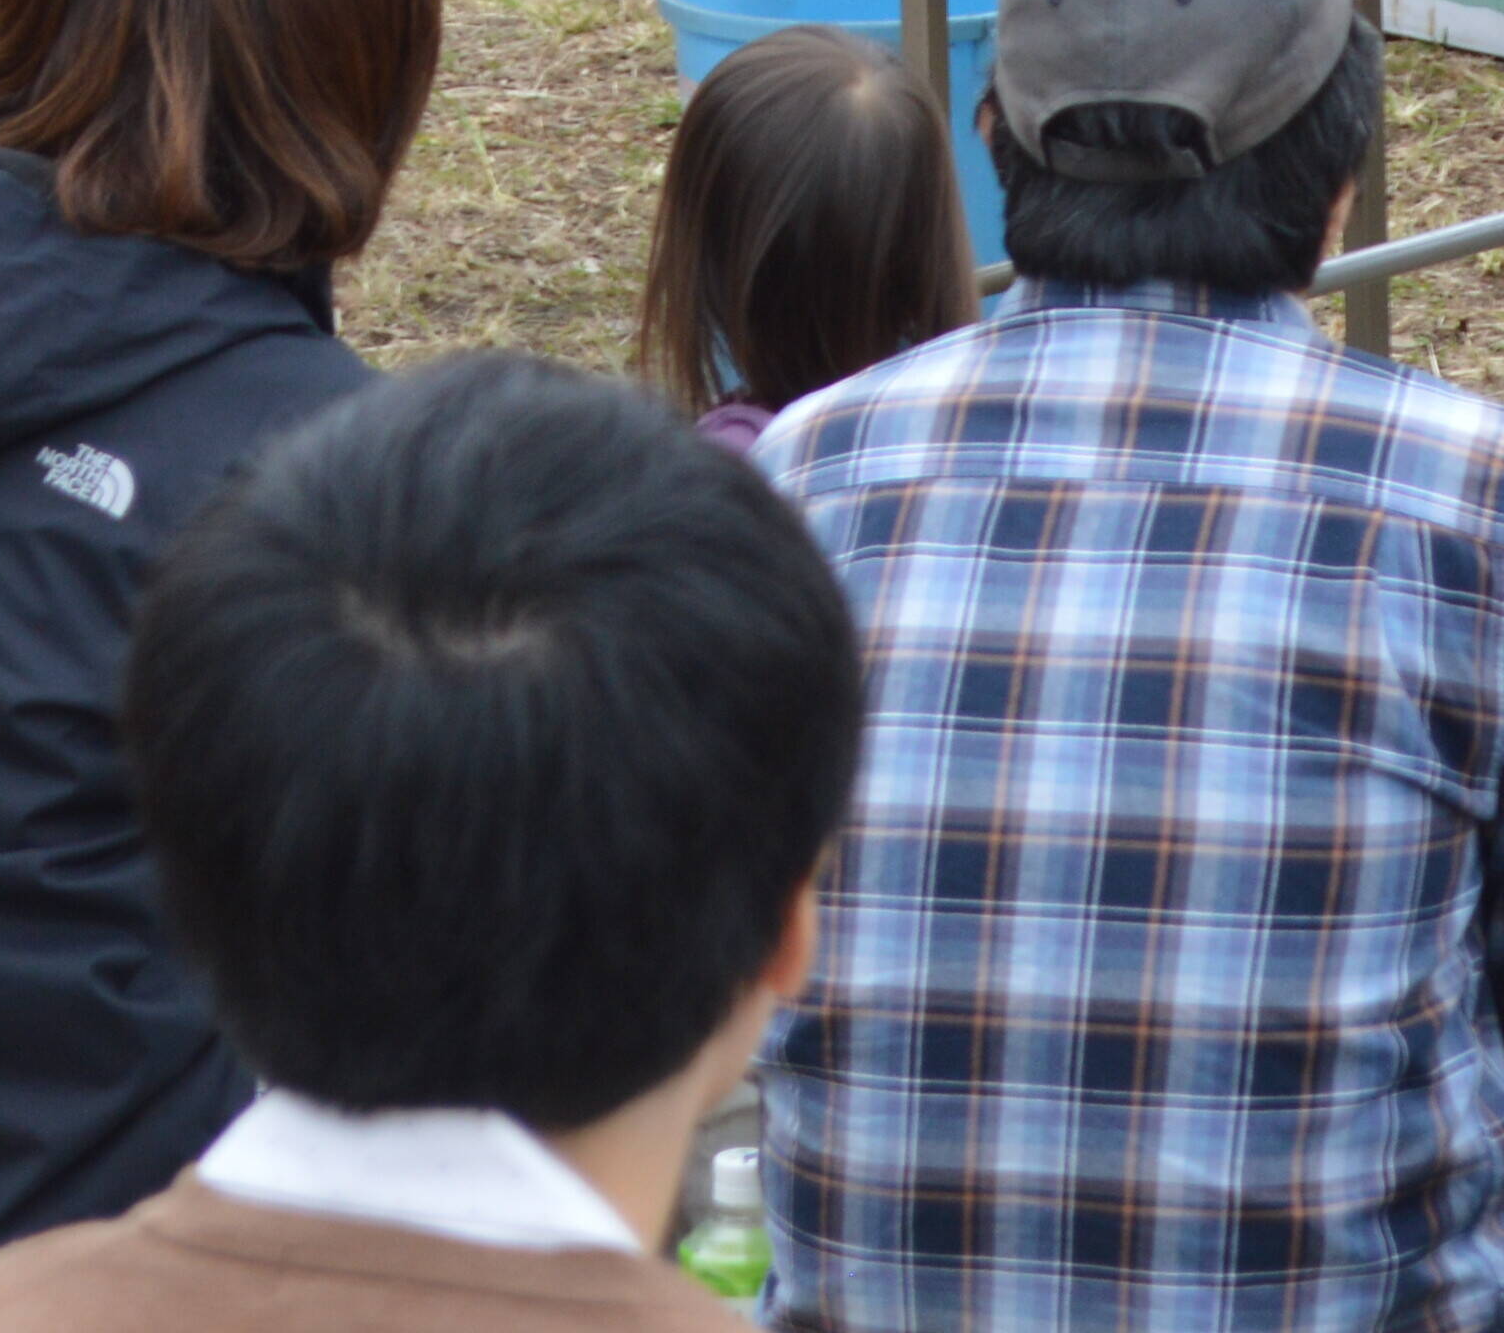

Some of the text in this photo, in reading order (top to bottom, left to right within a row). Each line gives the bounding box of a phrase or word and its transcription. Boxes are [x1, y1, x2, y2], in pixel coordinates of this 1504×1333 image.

[36, 446, 108, 483] NORTH
[77, 443, 113, 468] THE
[44, 468, 94, 499] FACE
